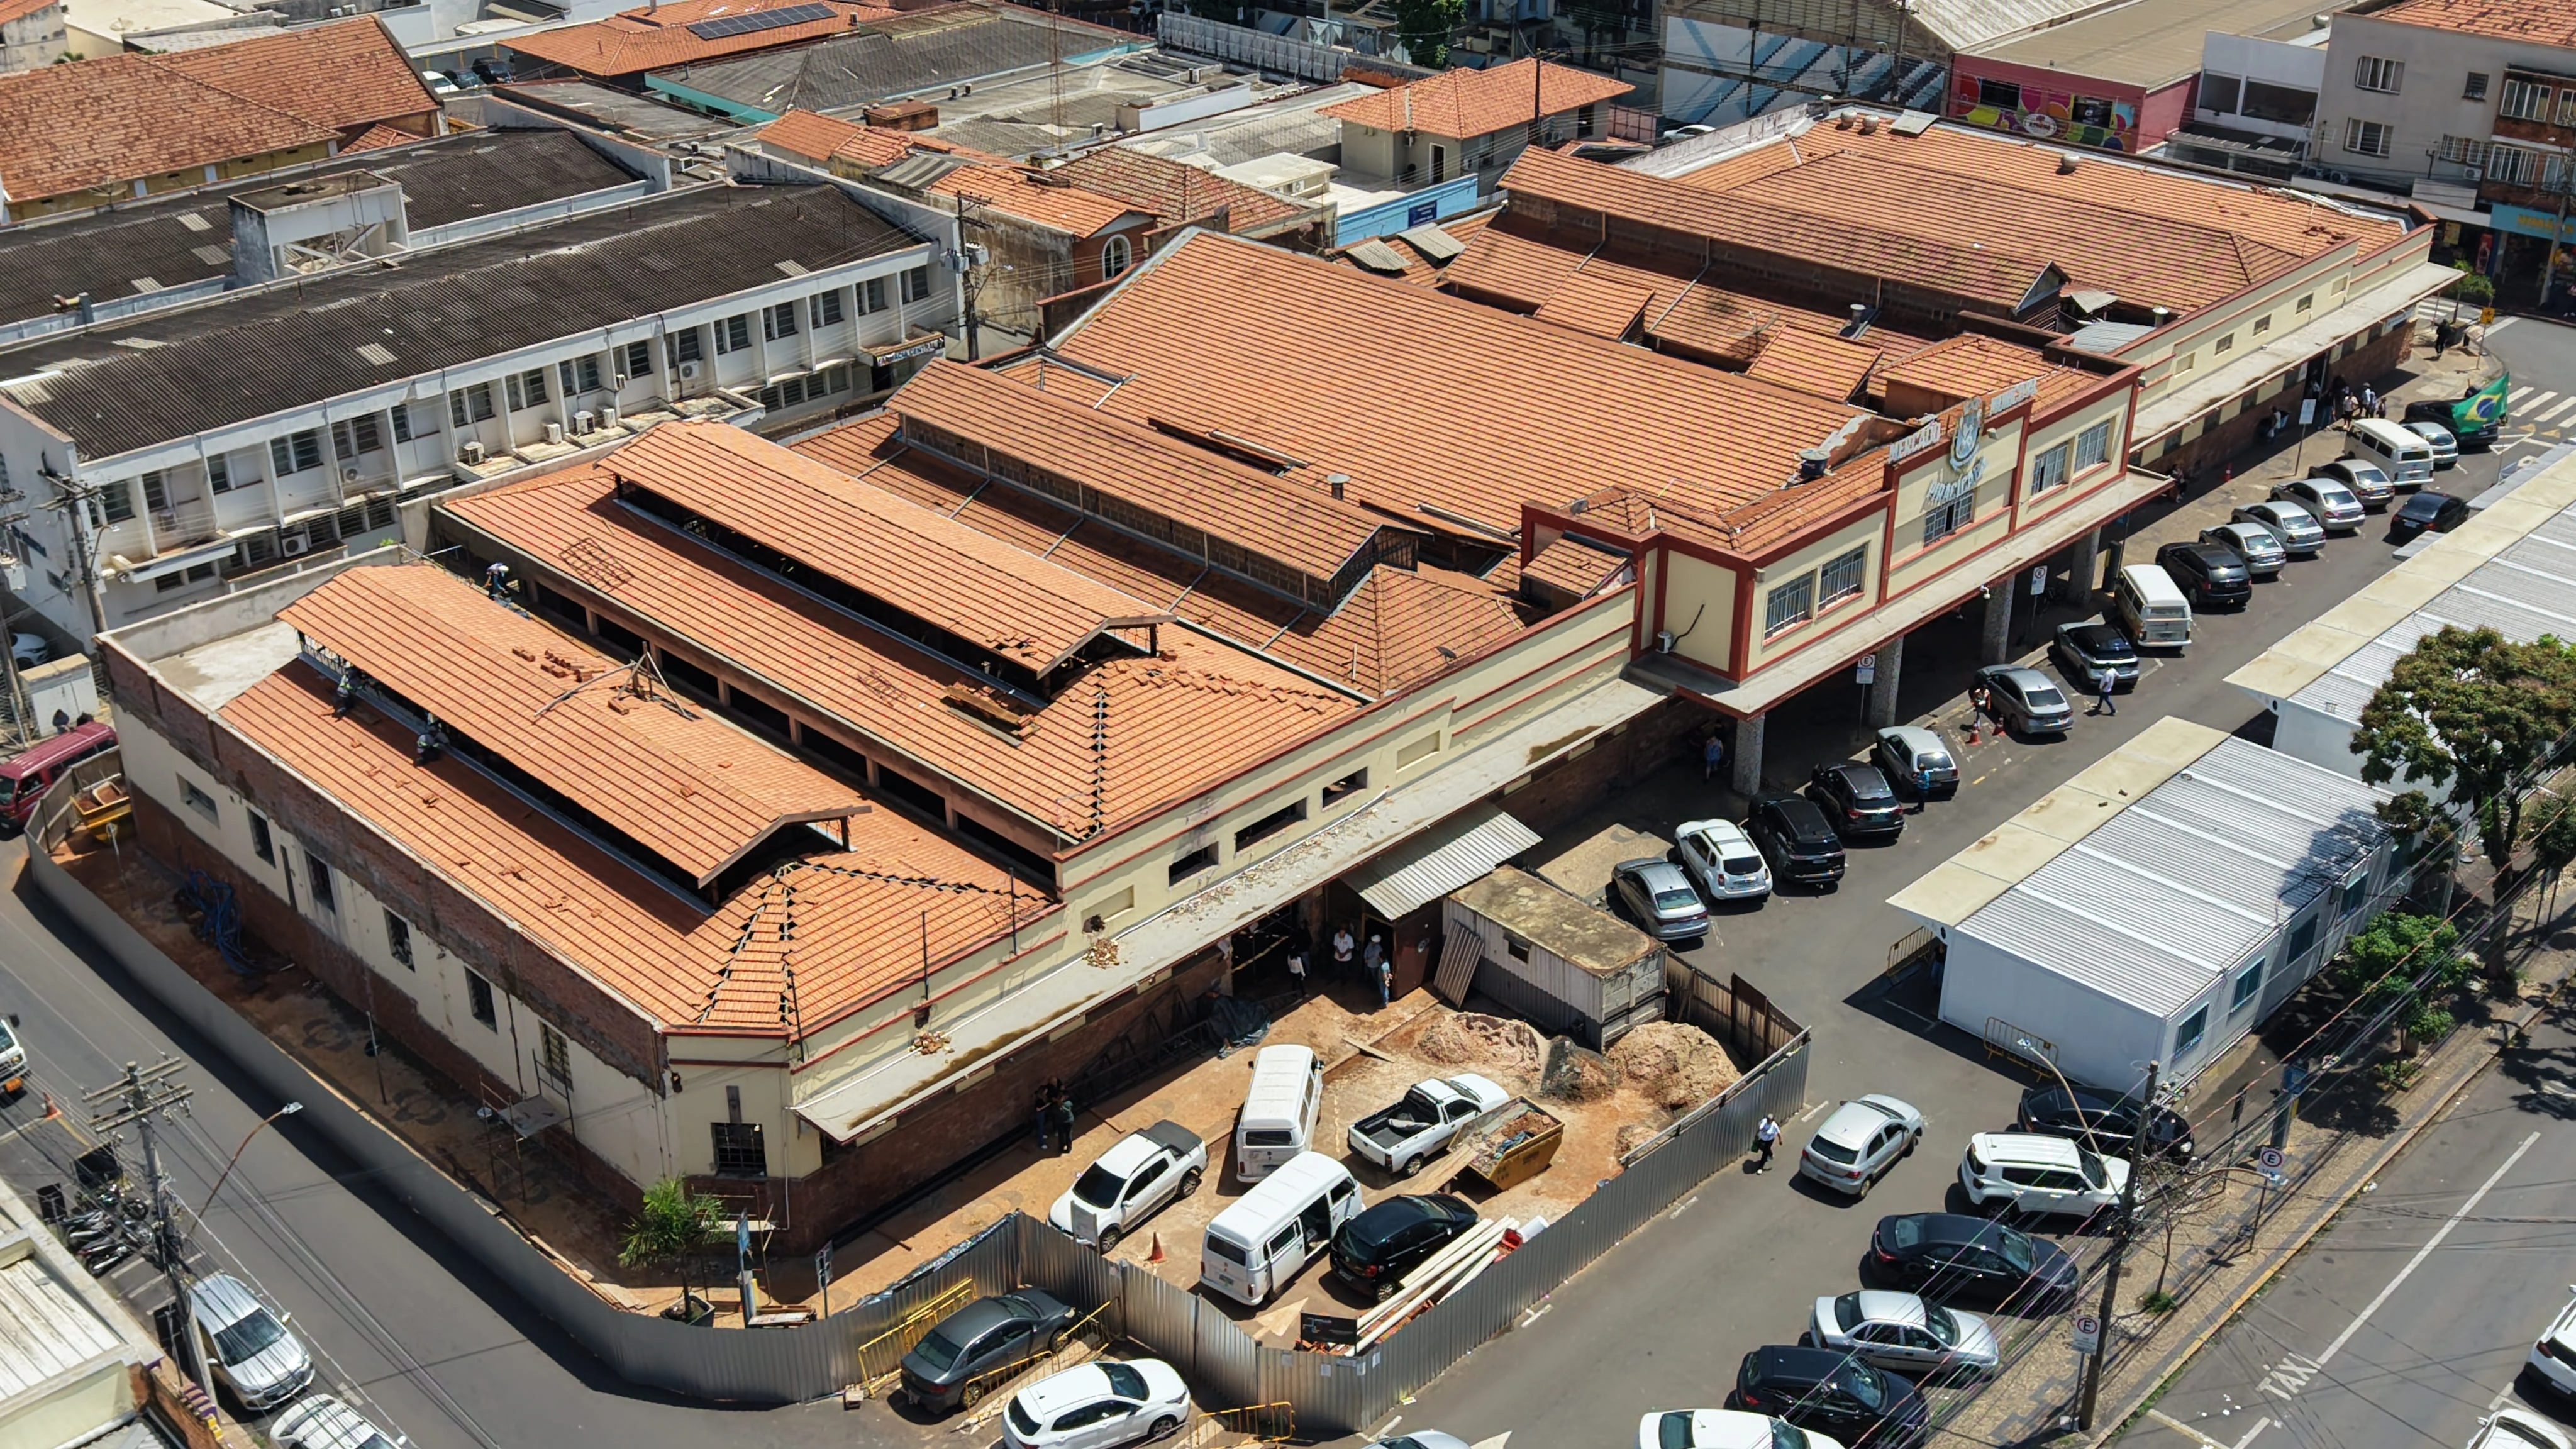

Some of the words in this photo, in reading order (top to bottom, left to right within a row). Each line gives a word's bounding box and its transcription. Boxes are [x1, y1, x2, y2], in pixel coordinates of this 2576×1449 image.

[1888, 420, 1941, 464] MERCADO
[2267, 1153, 2277, 1164] E
[2083, 1320, 2092, 1331] E
